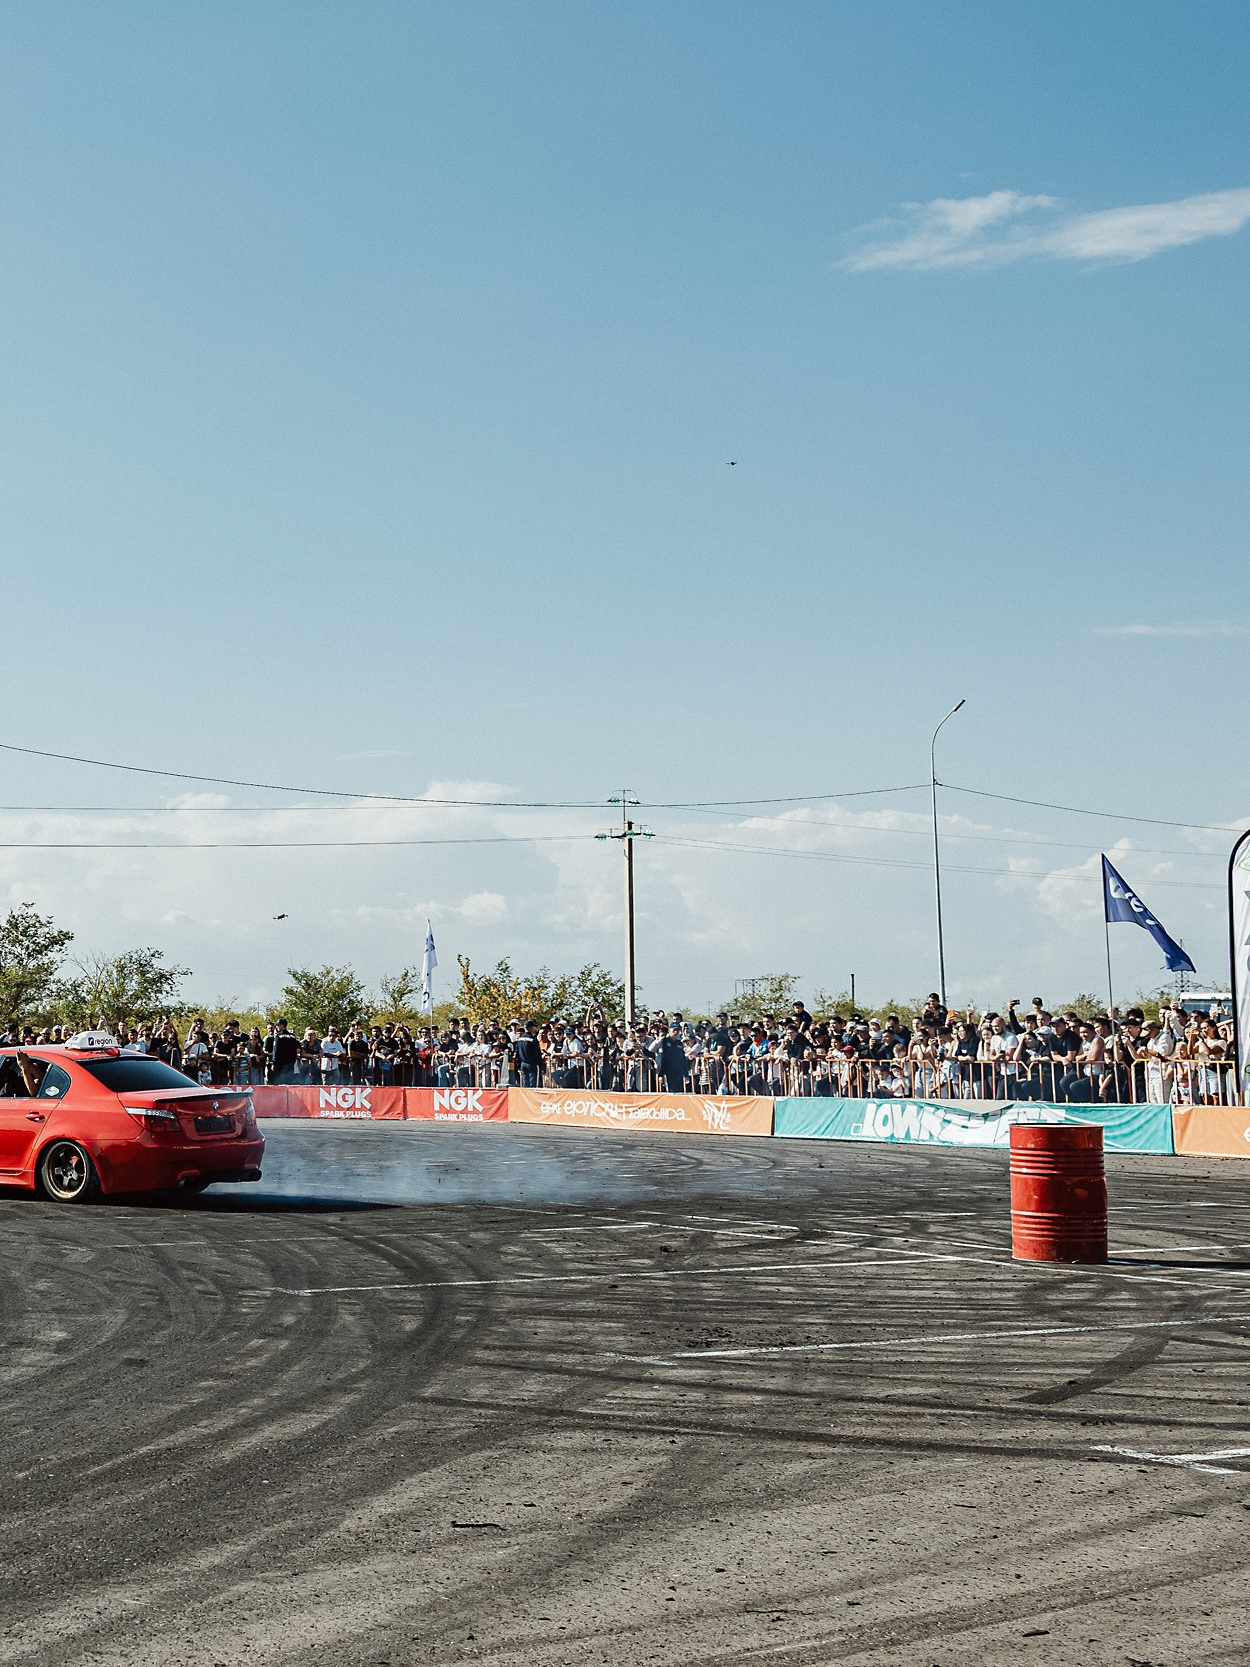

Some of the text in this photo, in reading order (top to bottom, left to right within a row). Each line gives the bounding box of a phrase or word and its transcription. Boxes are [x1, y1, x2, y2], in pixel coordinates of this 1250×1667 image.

[95, 1038, 113, 1047] region
[319, 1087, 372, 1109] NGK
[433, 1089, 484, 1112] NGK
[320, 1110, 372, 1118] SPARK PLUGS
[434, 1113, 484, 1121] SPARK PLUGS
